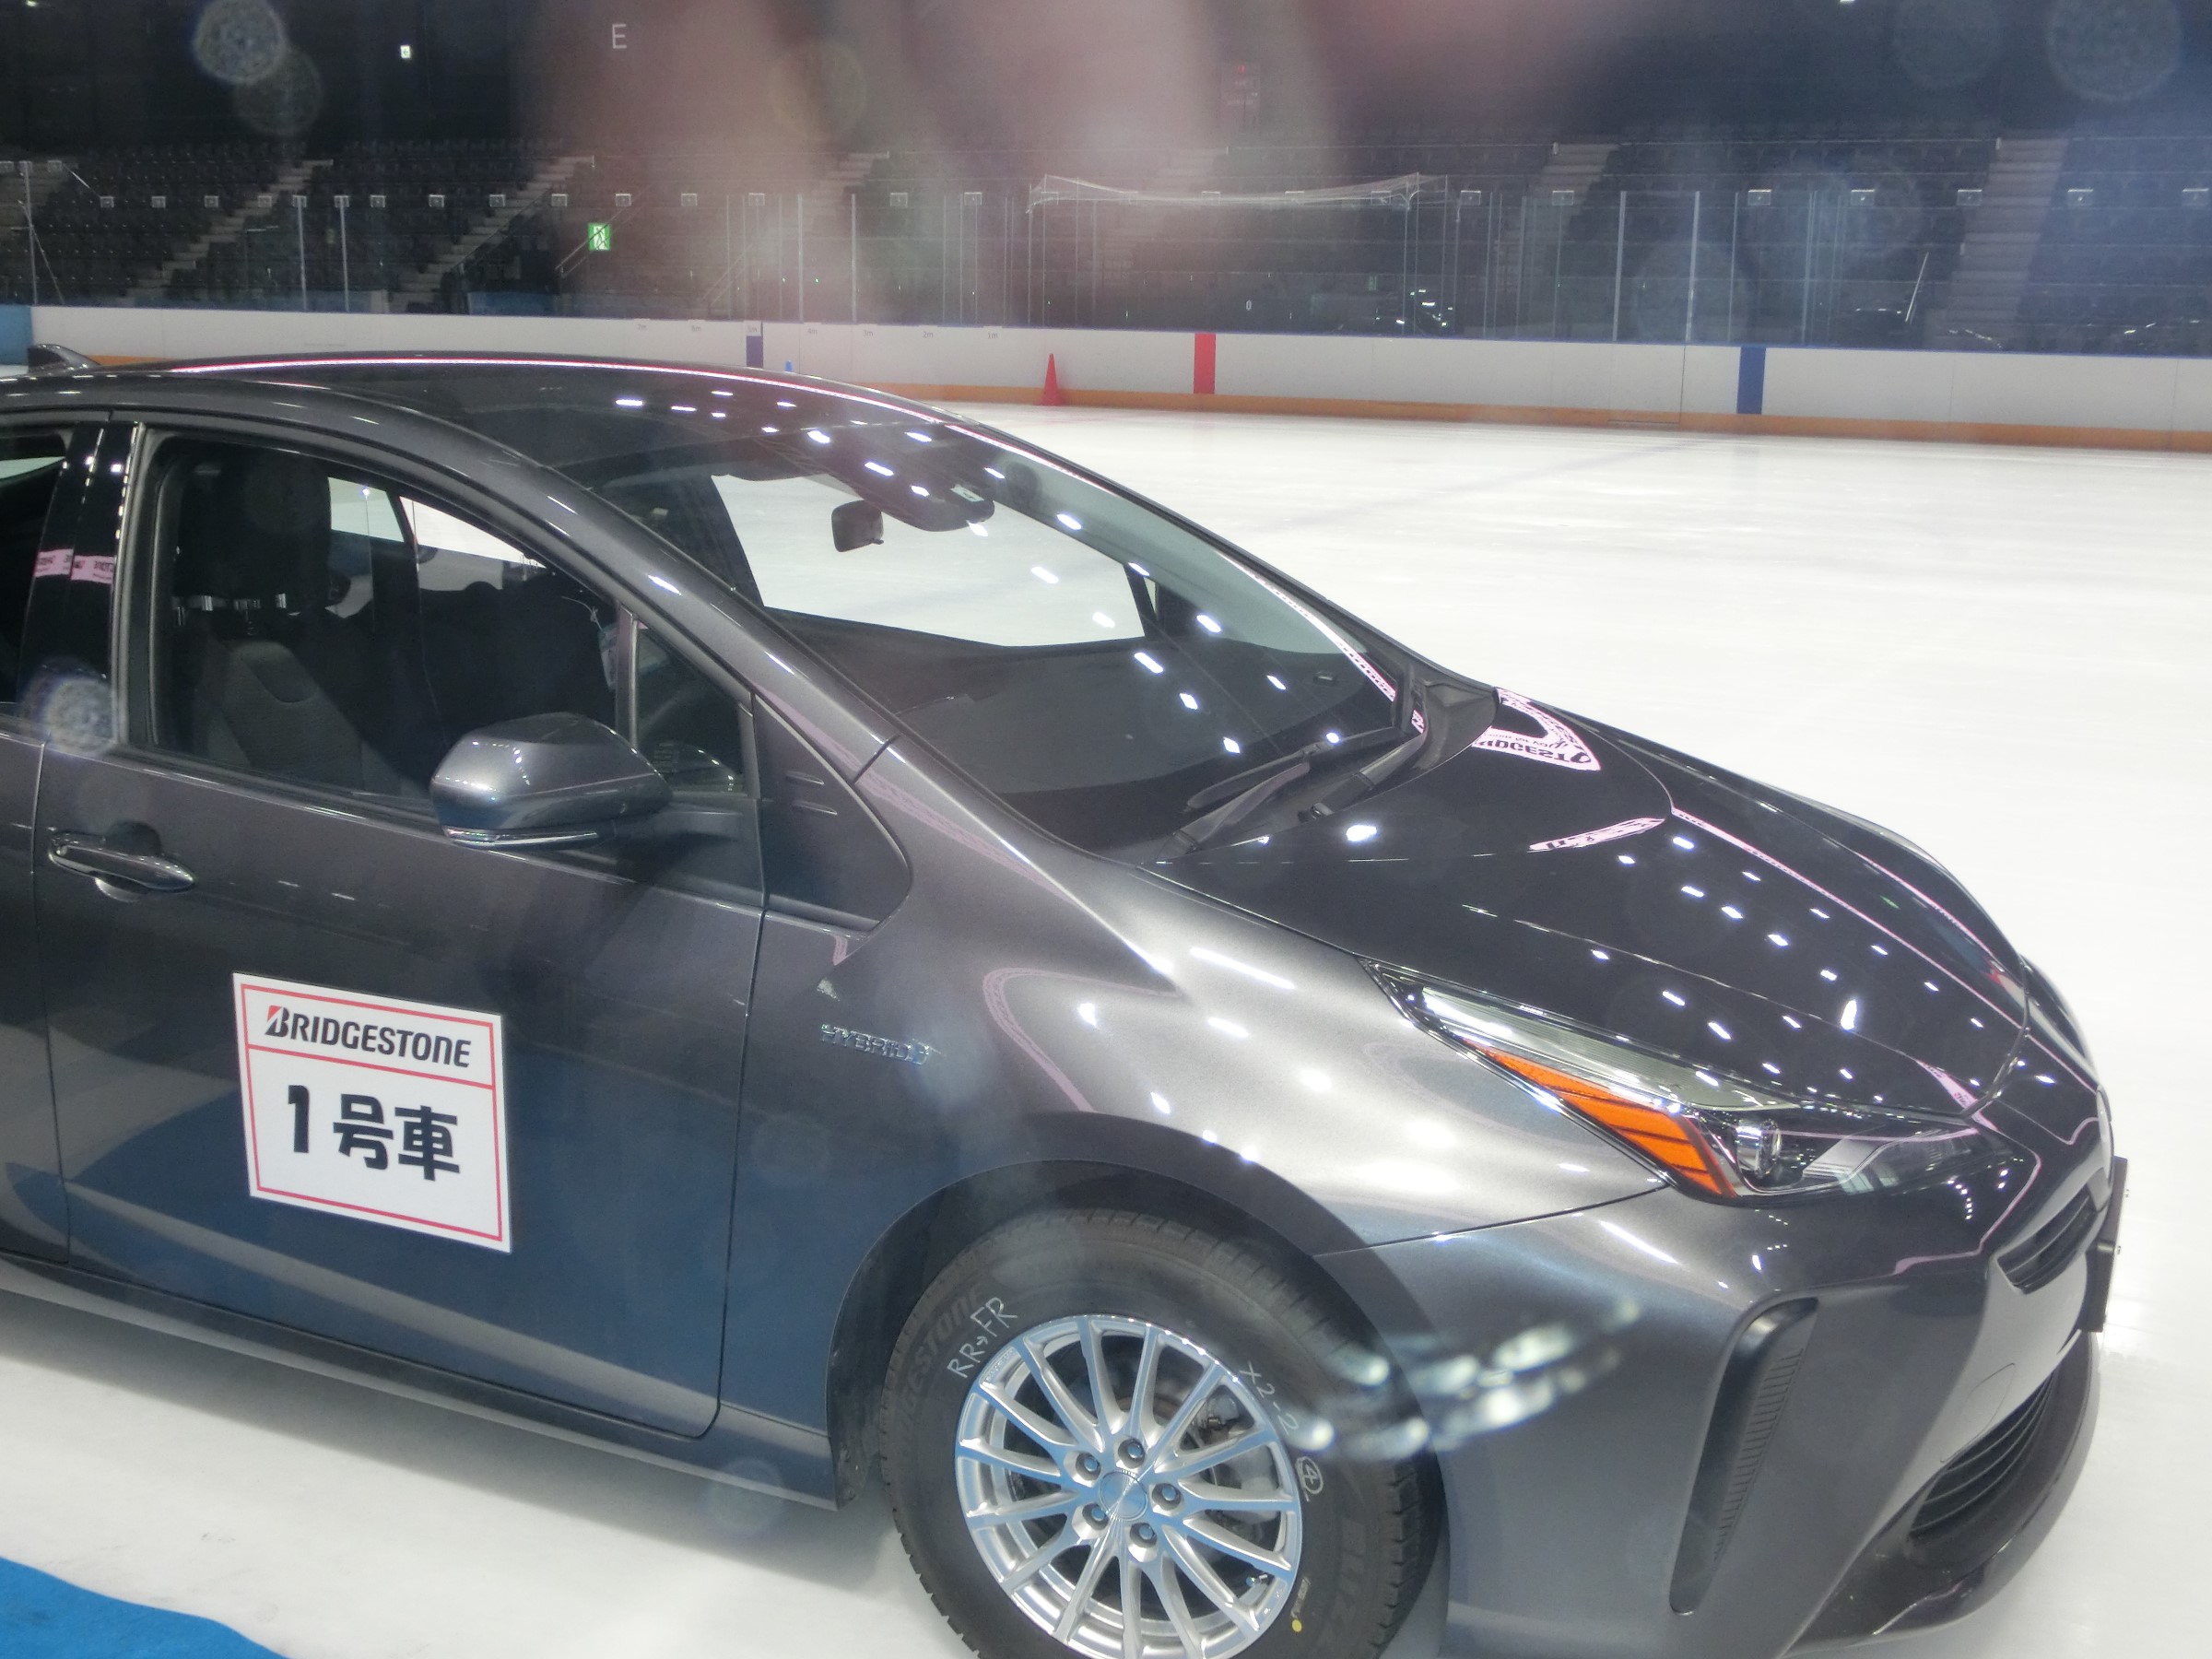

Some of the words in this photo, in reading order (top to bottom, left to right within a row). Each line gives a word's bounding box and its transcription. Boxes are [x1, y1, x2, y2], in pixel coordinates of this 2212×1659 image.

[612, 23, 628, 50] E
[264, 1005, 472, 1068] BRIDGESTONE
[288, 1083, 461, 1182] 1号車
